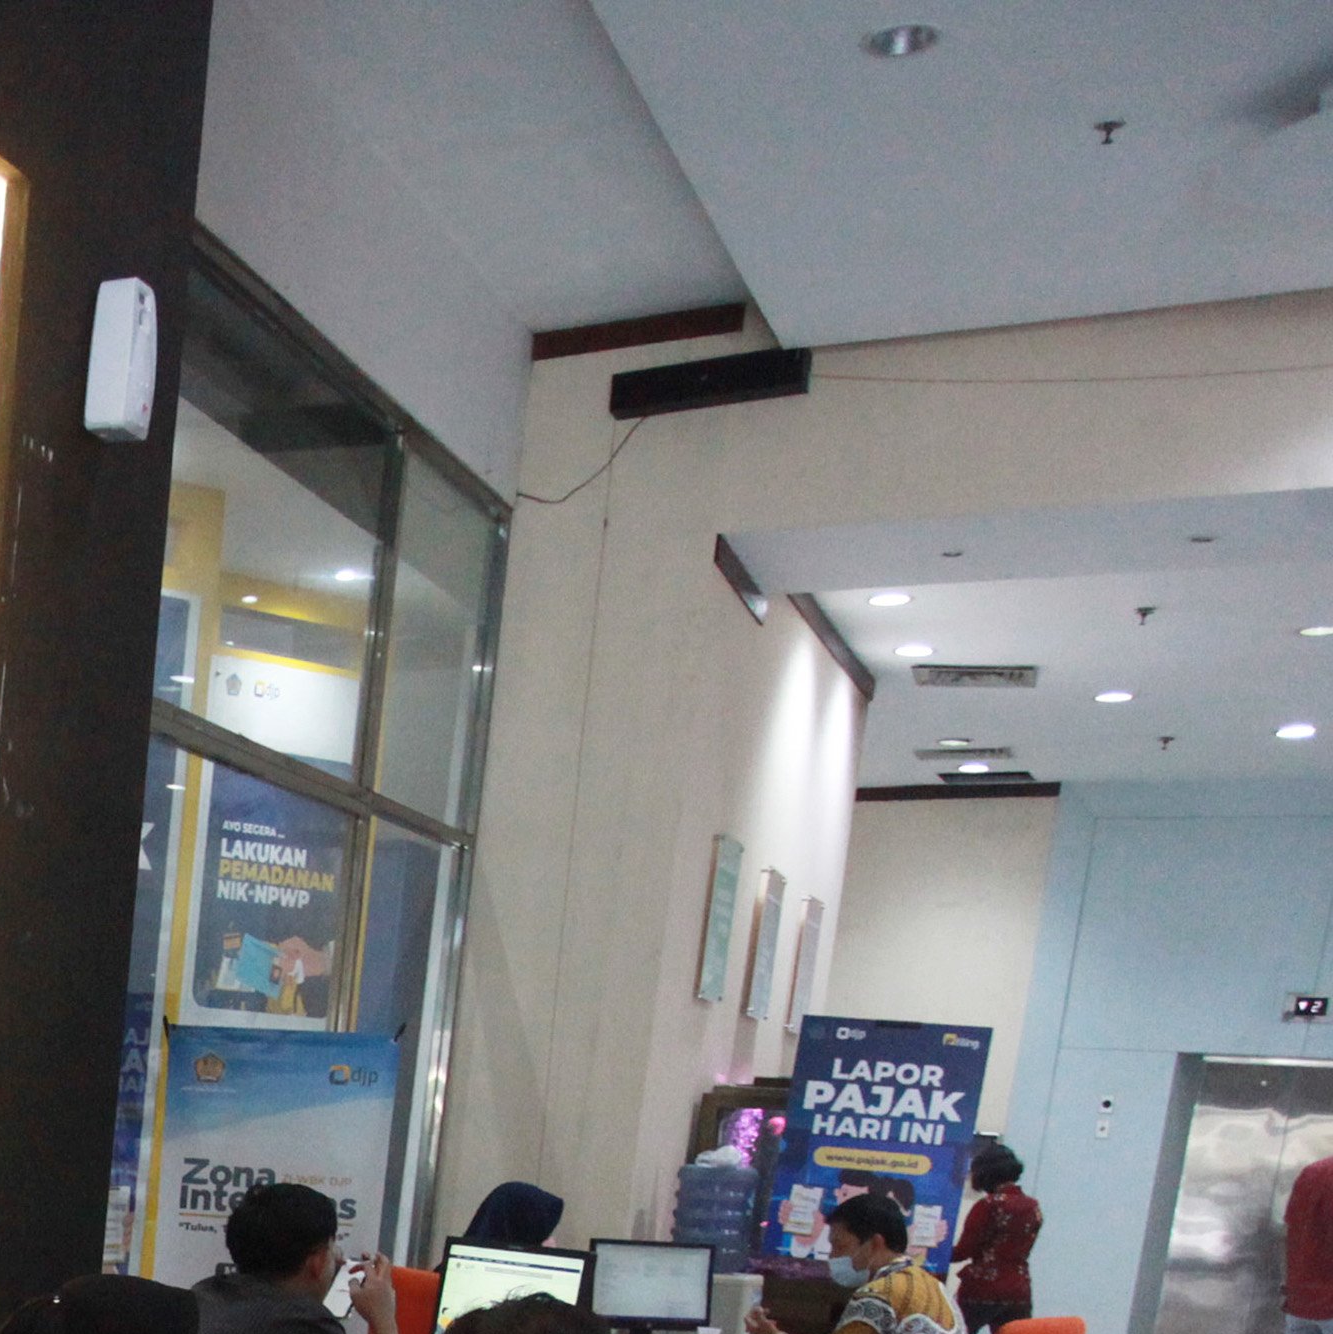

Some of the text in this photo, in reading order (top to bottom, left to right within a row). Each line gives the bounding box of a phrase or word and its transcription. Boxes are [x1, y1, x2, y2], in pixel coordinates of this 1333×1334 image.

[221, 820, 241, 832] AYO
[242, 822, 277, 838] SEGERA
[220, 837, 308, 868] LAKUKAN
[218, 858, 335, 893] PEMADANAN
[216, 879, 311, 909] NIK-NPWP
[1310, 1001, 1322, 1012] 2
[351, 1067, 379, 1087] djp
[831, 1058, 945, 1088] LAPOR
[802, 1080, 966, 1123] PAJAK
[811, 1114, 946, 1146] HARI INI
[182, 1157, 276, 1188] Zona
